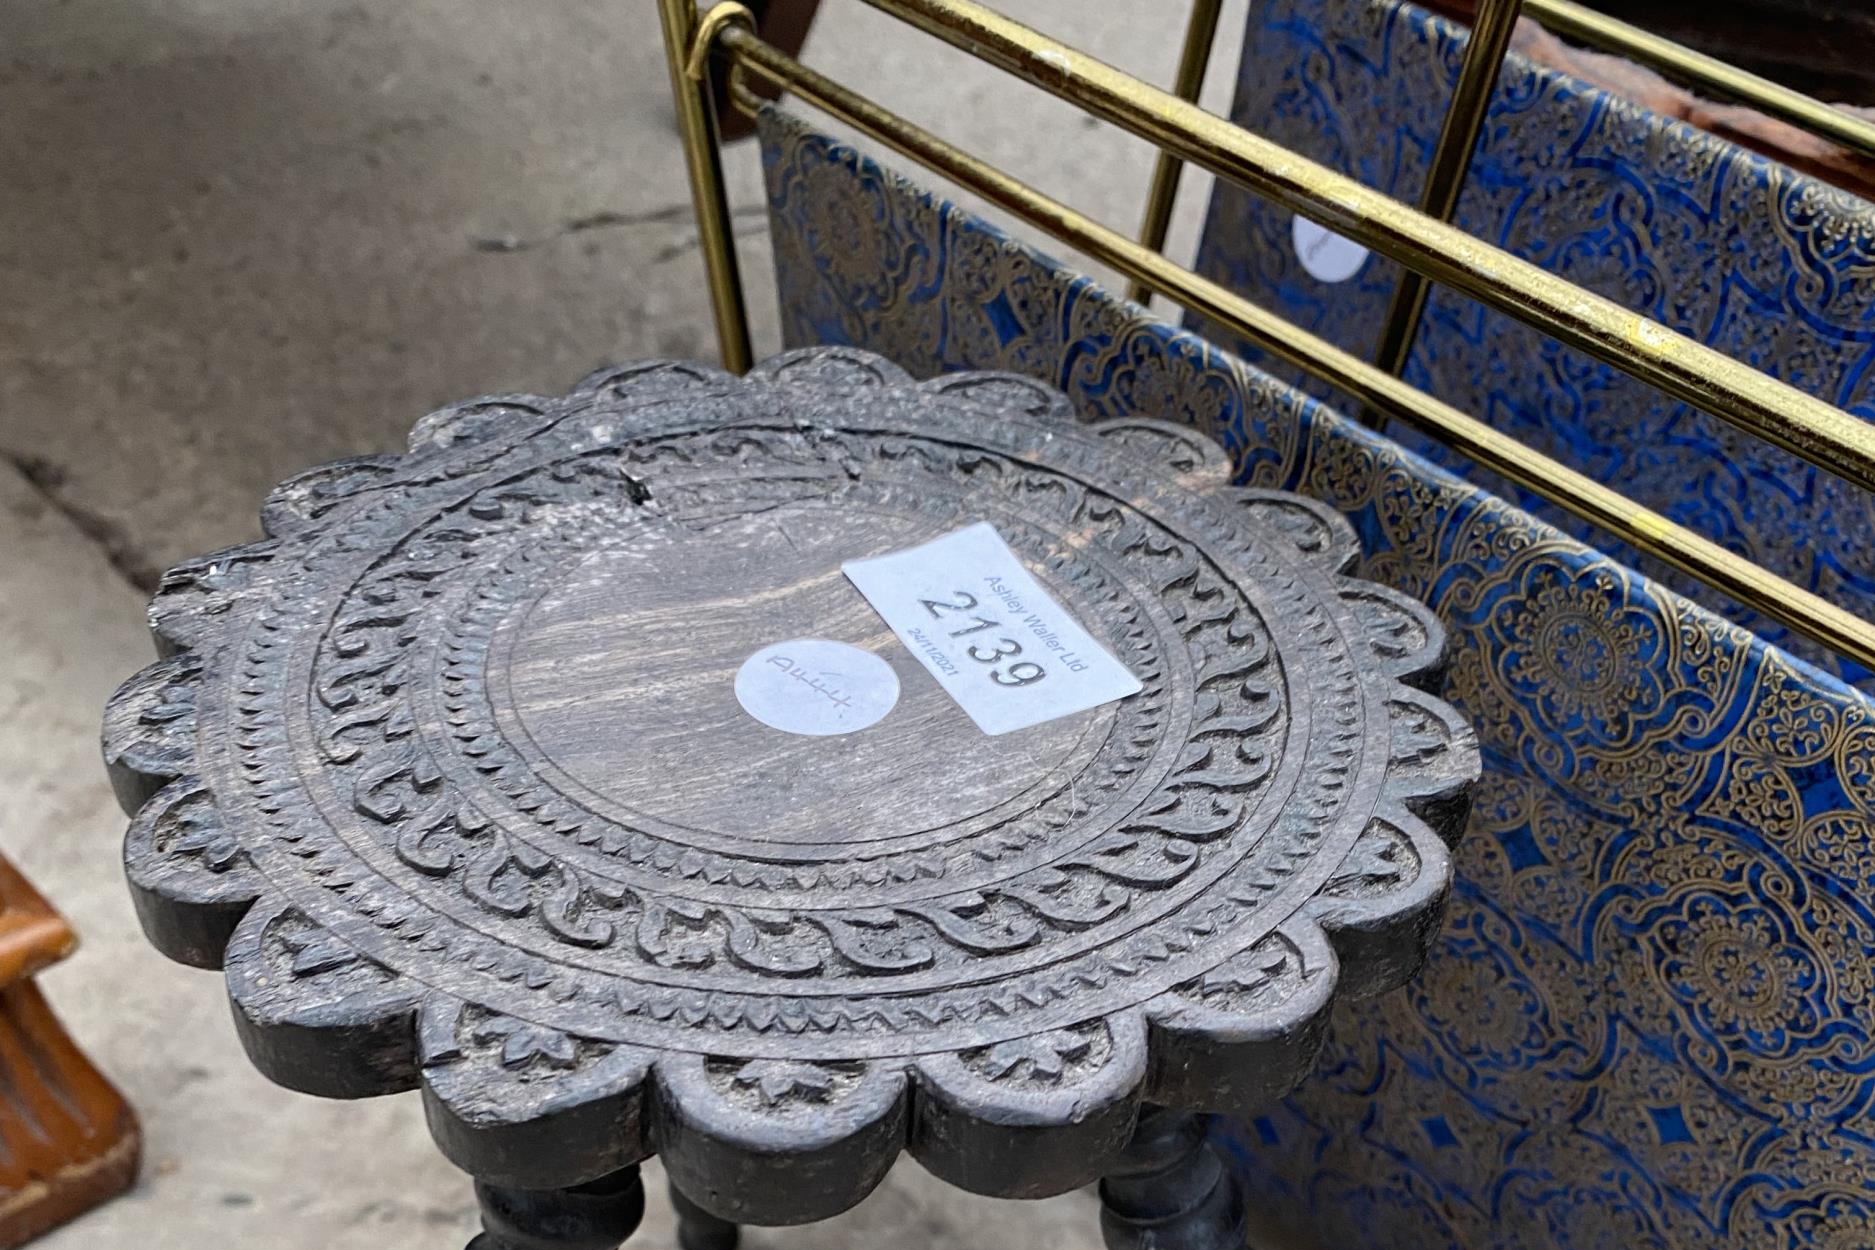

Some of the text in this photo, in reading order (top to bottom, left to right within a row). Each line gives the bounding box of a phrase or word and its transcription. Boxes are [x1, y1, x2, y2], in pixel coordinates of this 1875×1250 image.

[907, 627, 959, 676] 24/11/2021
[917, 591, 1047, 687] 2139
[984, 575, 1089, 673] Ashley Waller Ltd
